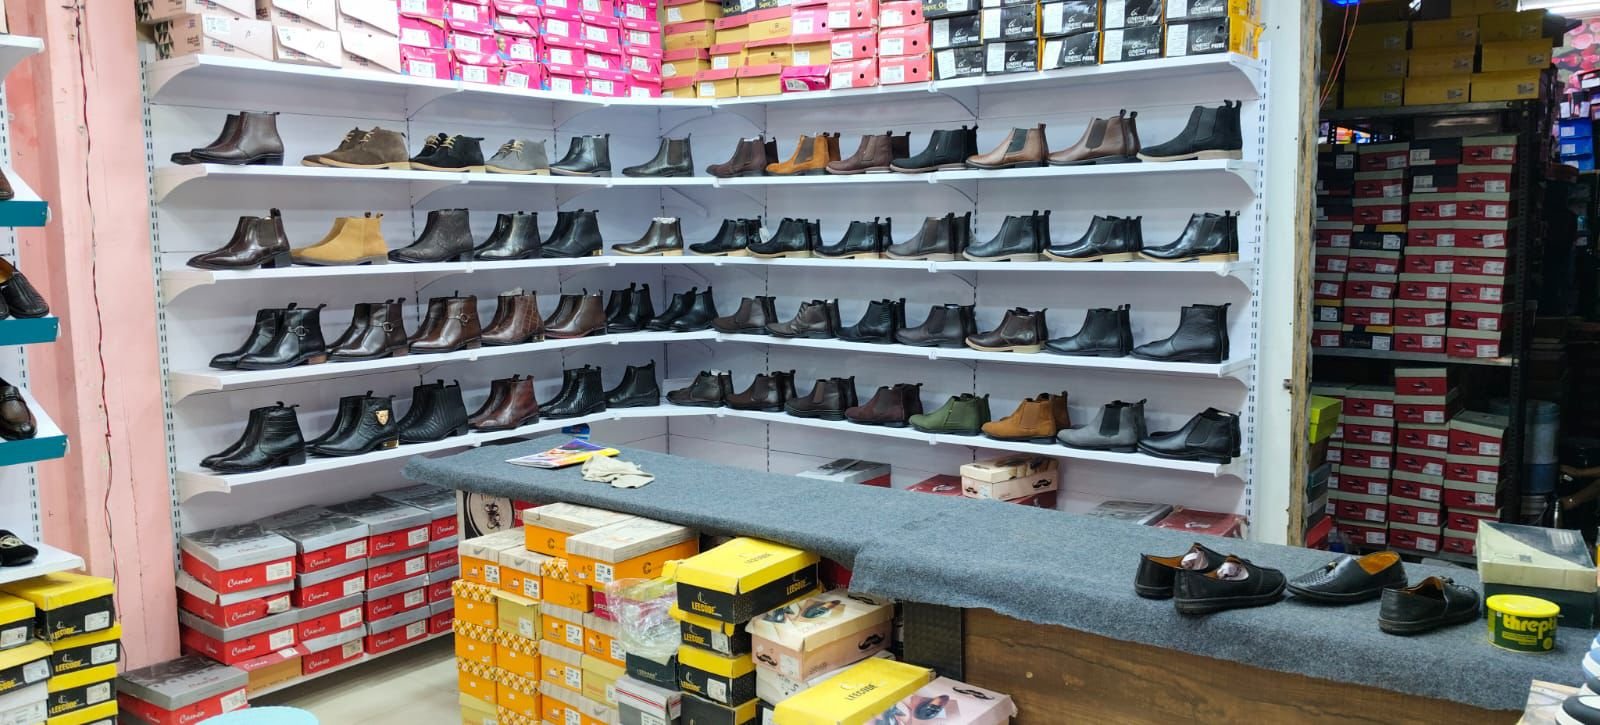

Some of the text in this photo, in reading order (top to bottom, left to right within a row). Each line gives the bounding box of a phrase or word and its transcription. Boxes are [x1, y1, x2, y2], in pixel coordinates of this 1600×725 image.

[227, 576, 254, 588] Cameo
[691, 600, 716, 615] LEECODE
[231, 609, 256, 621] Cameo
[231, 644, 256, 656] Cameo
[55, 660, 82, 673] LEECODE
[179, 711, 206, 724] Cameo
